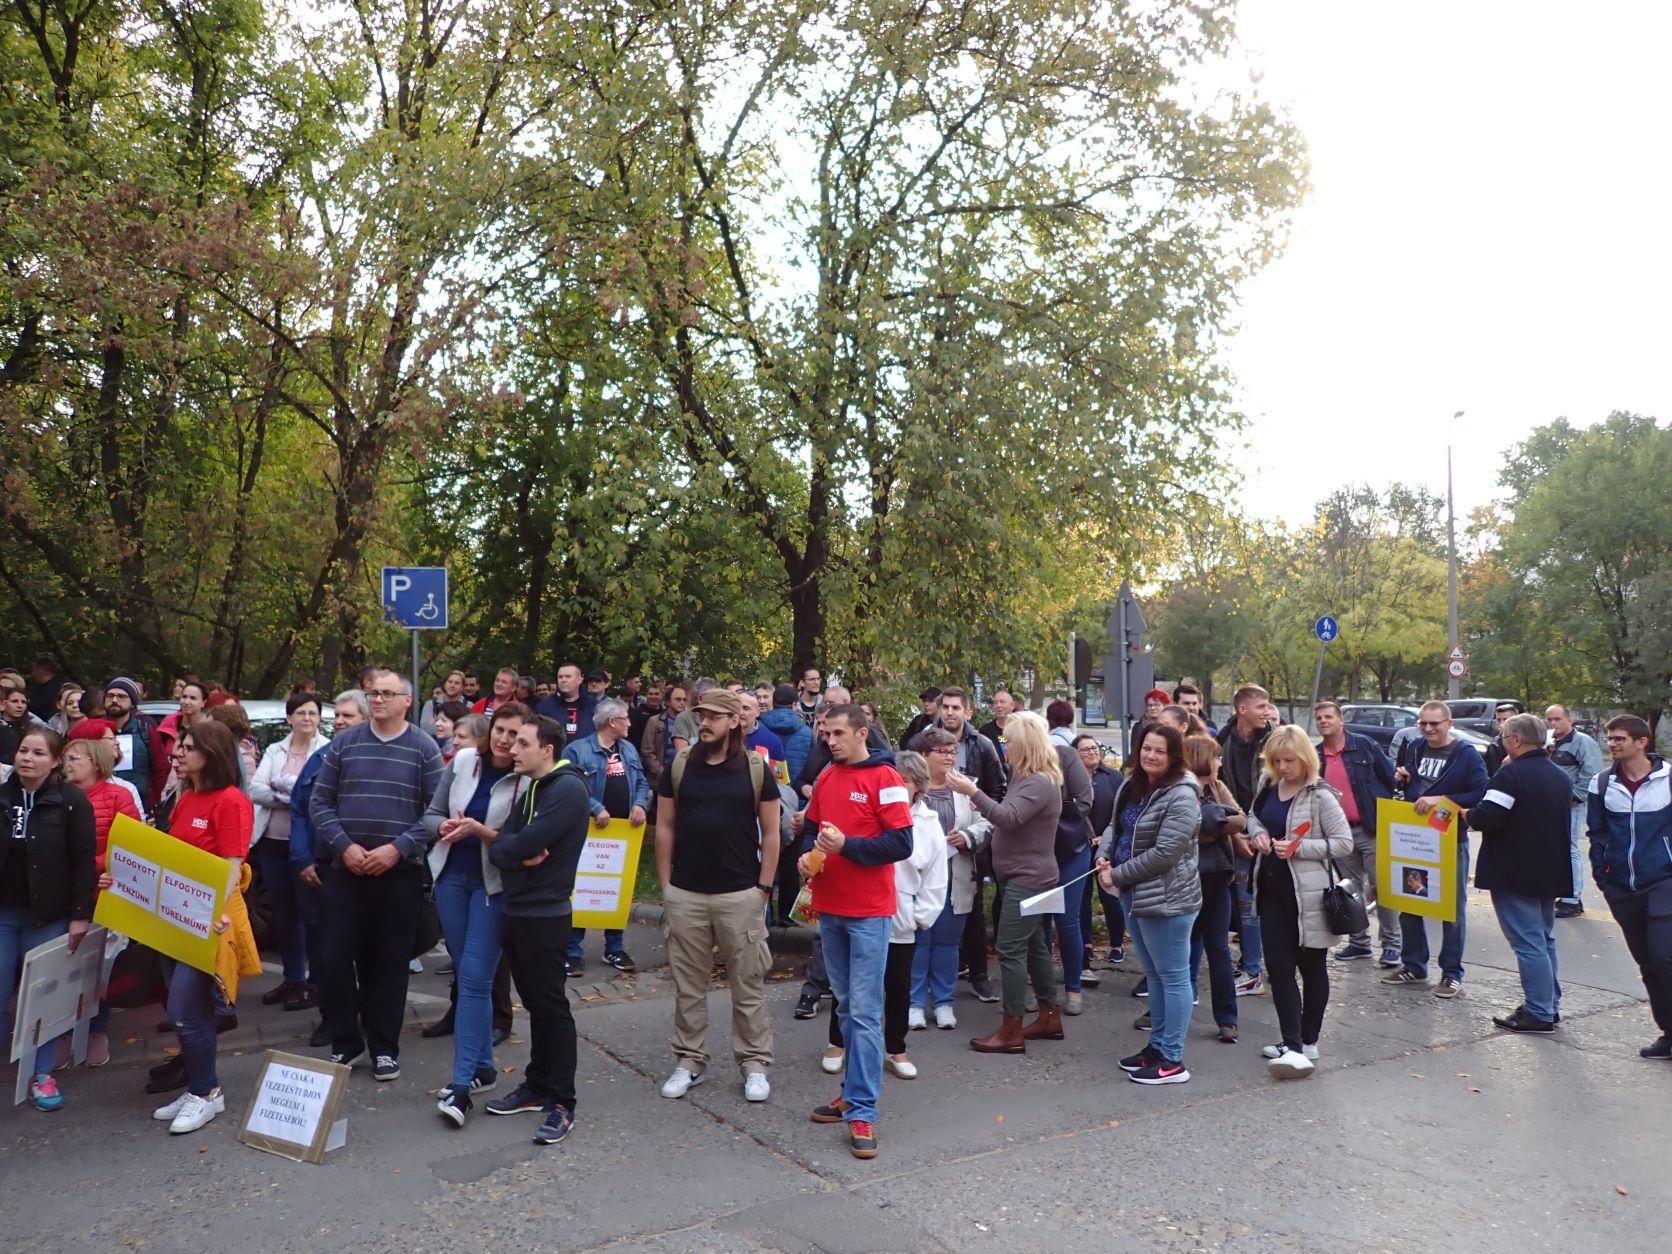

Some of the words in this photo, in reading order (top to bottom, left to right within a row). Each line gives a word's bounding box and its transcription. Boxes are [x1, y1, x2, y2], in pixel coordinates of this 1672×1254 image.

[390, 575, 411, 602] P
[113, 852, 157, 878] ELFOGYOTT
[132, 875, 138, 883] A
[165, 876, 213, 902] ELFOGYOTT
[182, 900, 188, 908] A
[290, 1071, 309, 1083] CSAK
